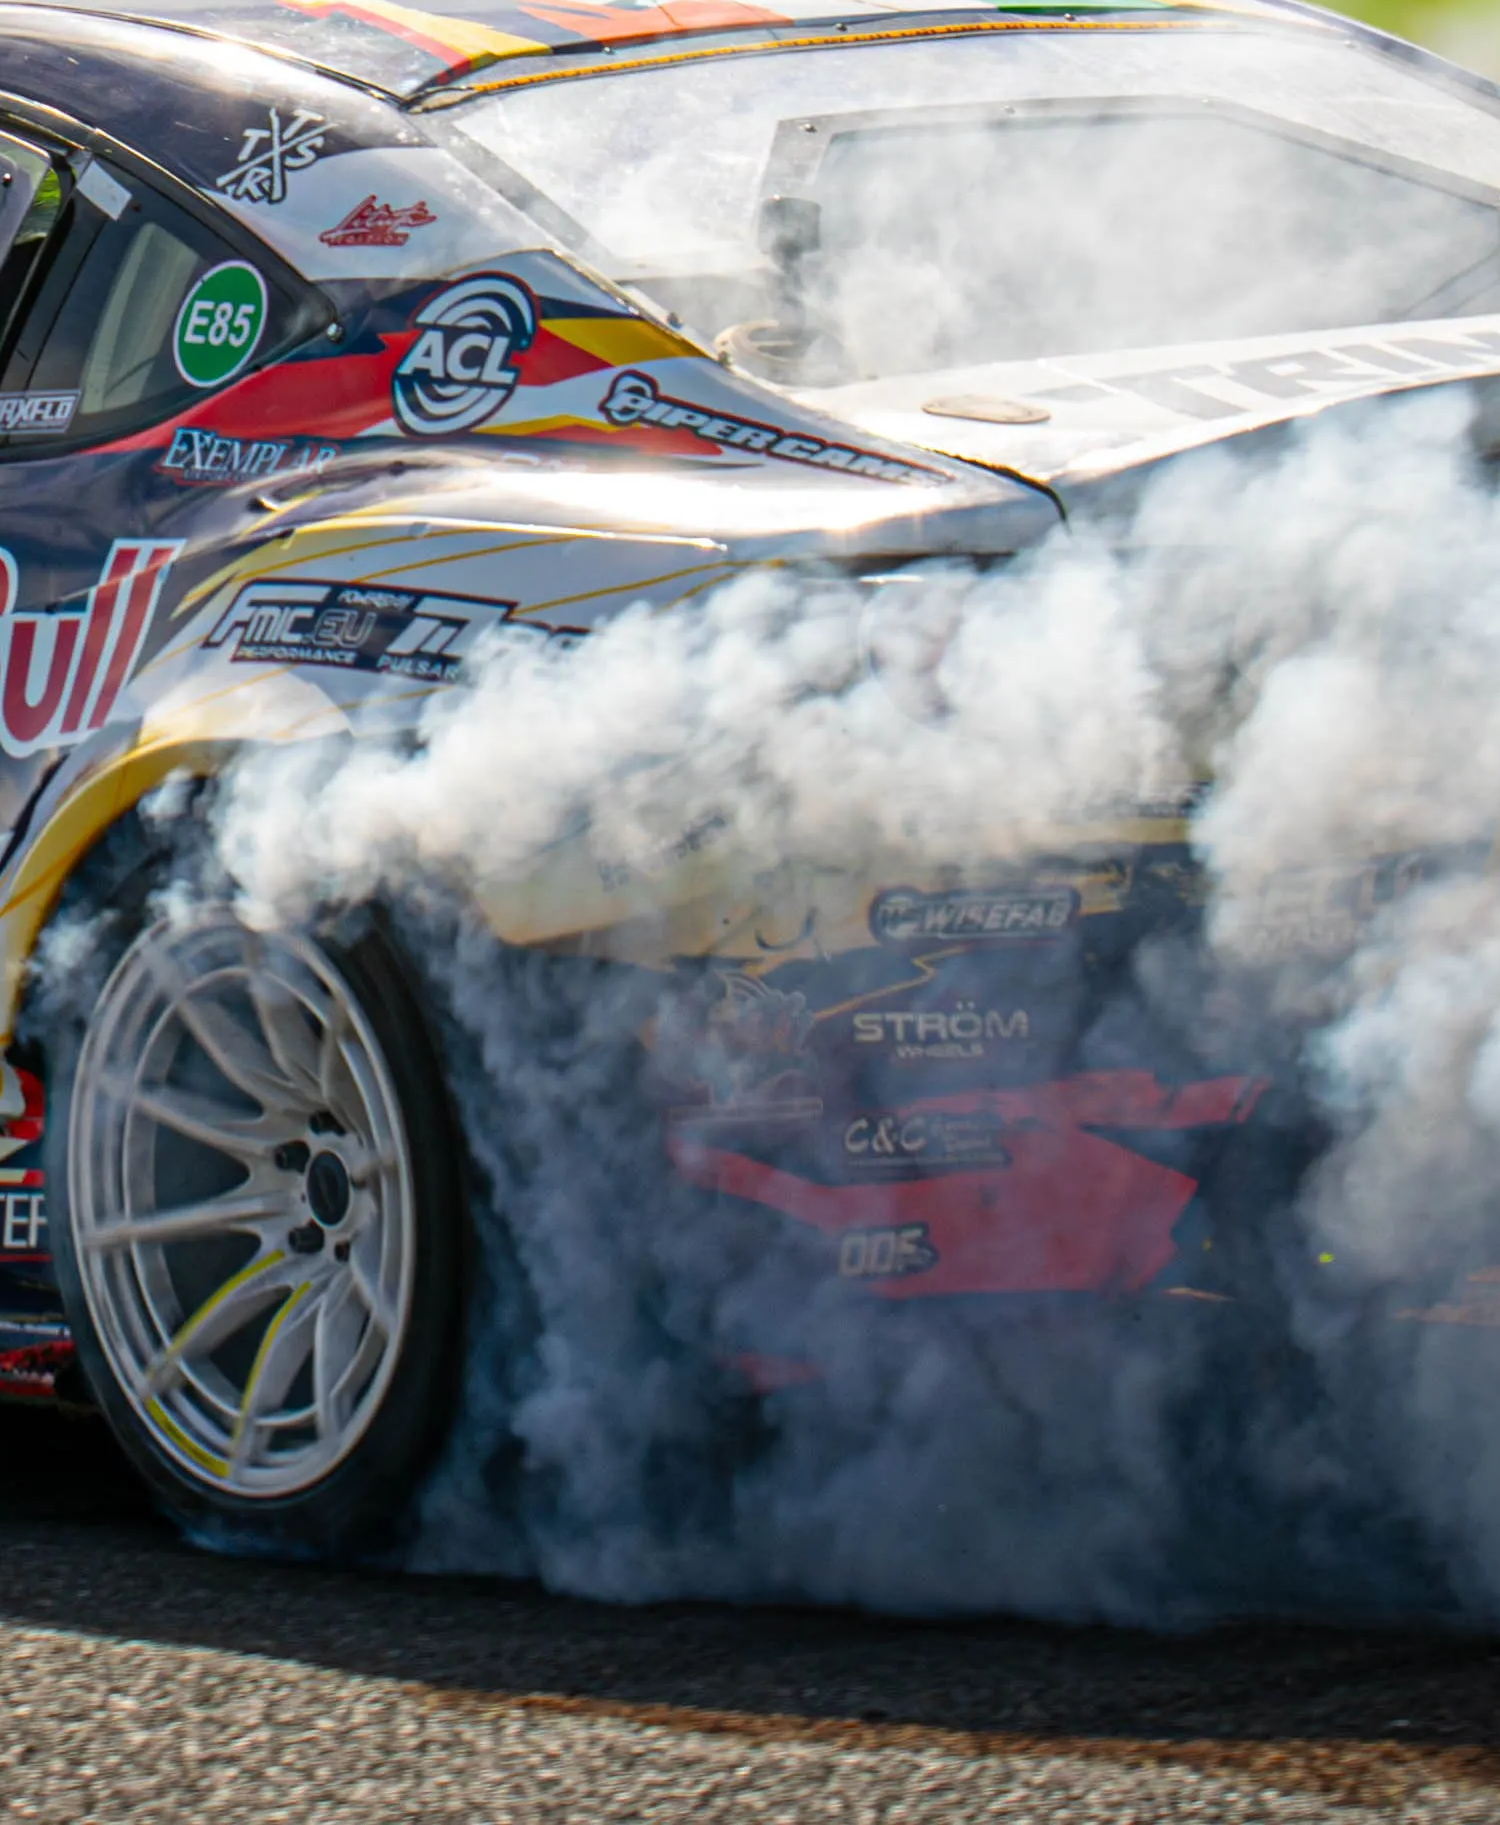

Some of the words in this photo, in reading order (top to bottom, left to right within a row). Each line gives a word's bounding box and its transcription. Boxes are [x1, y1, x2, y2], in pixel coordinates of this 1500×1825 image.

[184, 300, 255, 348] E85
[397, 329, 516, 384] ACL
[163, 427, 337, 474] EXEMPLAR
[236, 646, 358, 665] PERFORMANCE
[853, 1001, 1030, 1043] STRÖM
